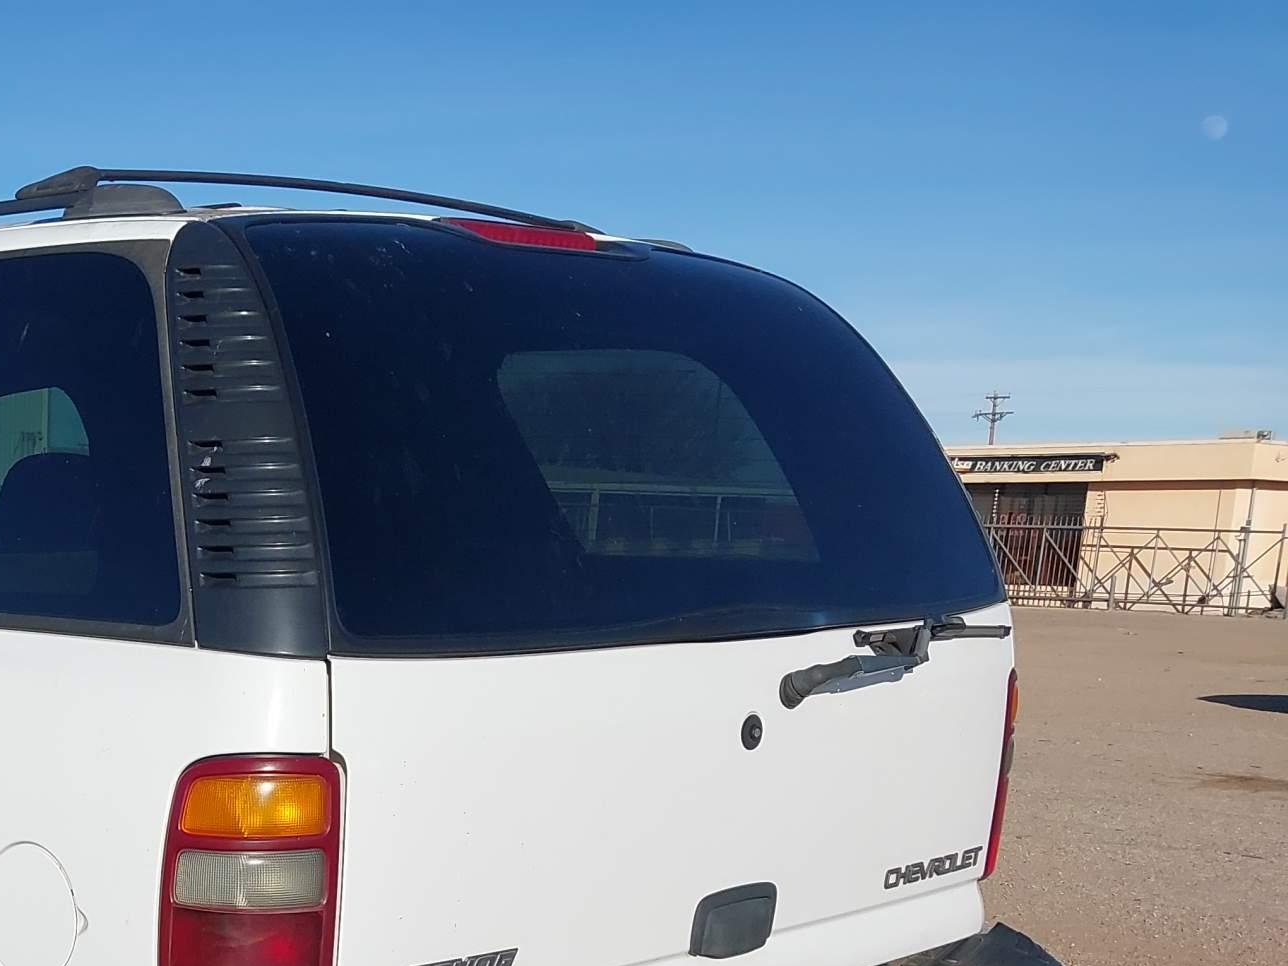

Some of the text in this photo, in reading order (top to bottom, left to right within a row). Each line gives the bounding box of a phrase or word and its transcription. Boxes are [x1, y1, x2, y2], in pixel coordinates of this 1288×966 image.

[974, 460, 1036, 472] BANKING
[1040, 458, 1096, 471] CENTER
[884, 845, 983, 890] CHEVROLET
